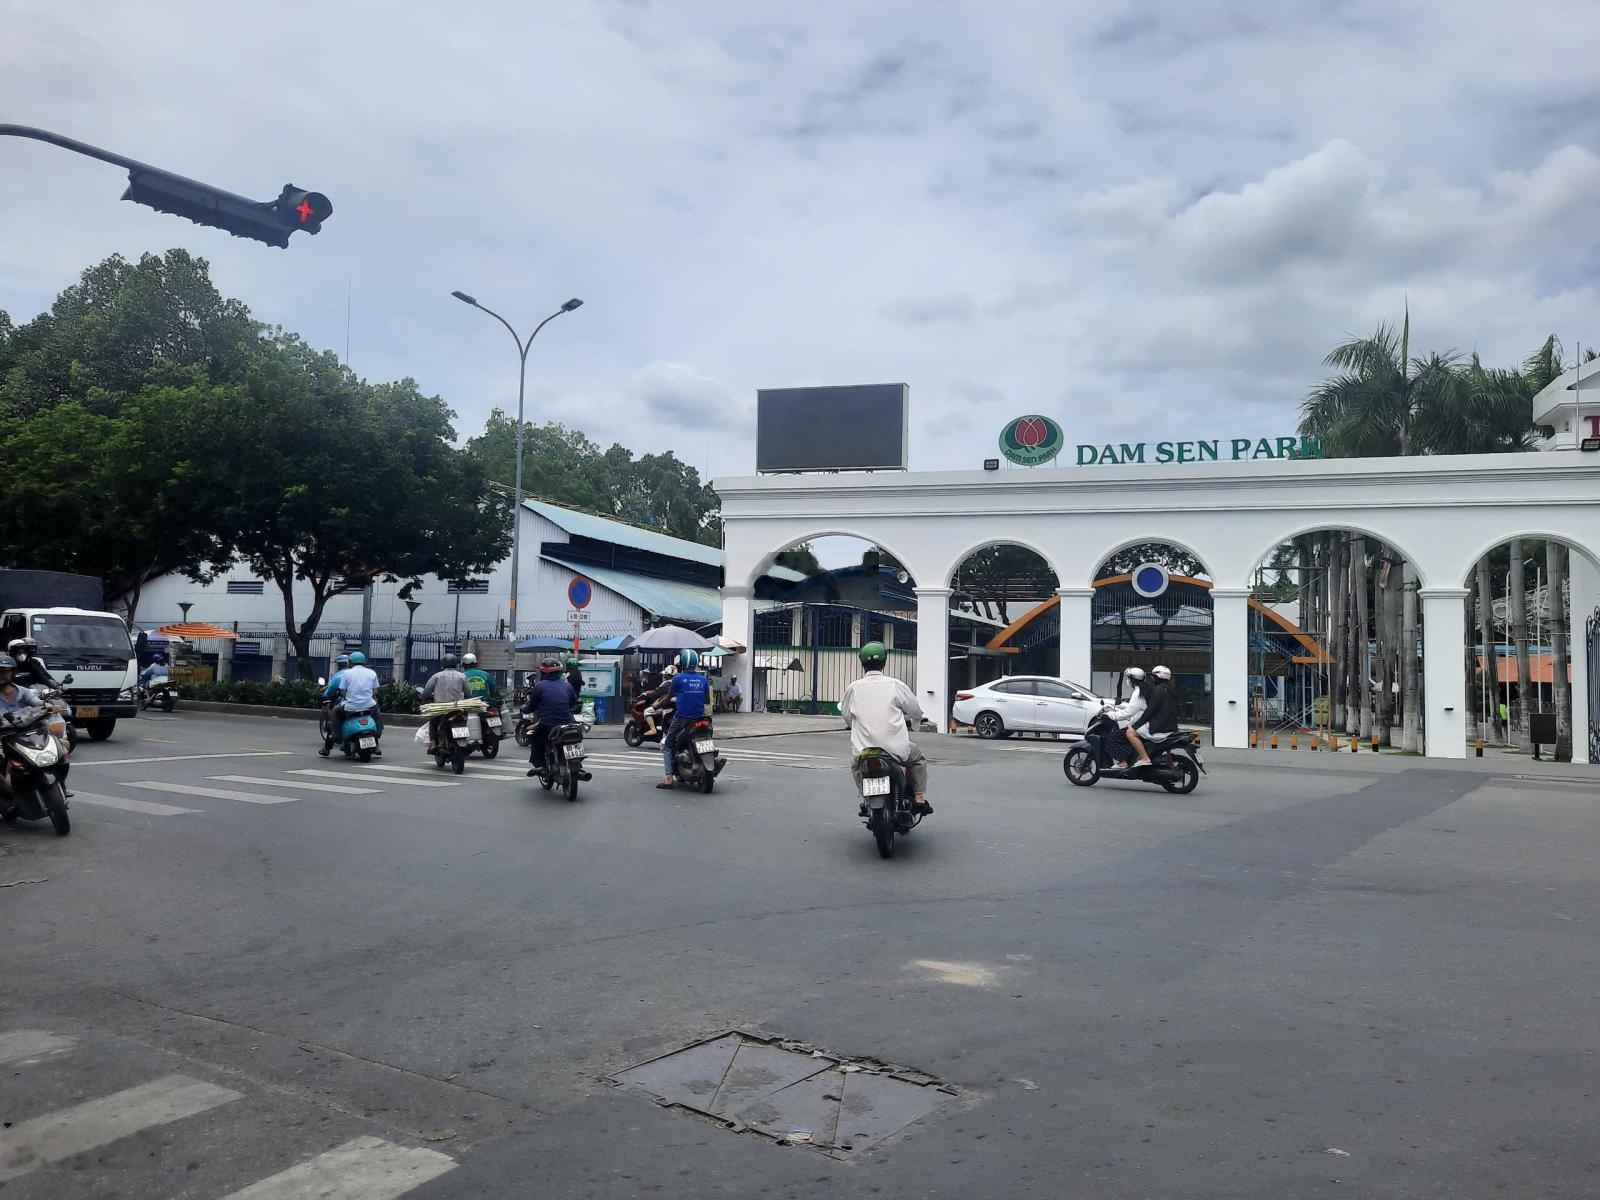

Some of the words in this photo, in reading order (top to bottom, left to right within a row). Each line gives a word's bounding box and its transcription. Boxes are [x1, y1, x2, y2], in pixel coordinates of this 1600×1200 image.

[1004, 449, 1022, 463] DAM
[1022, 455, 1037, 464] SEN
[1076, 442, 1146, 465] DAM
[1155, 439, 1219, 464] SEN
[1230, 434, 1325, 461] PARK
